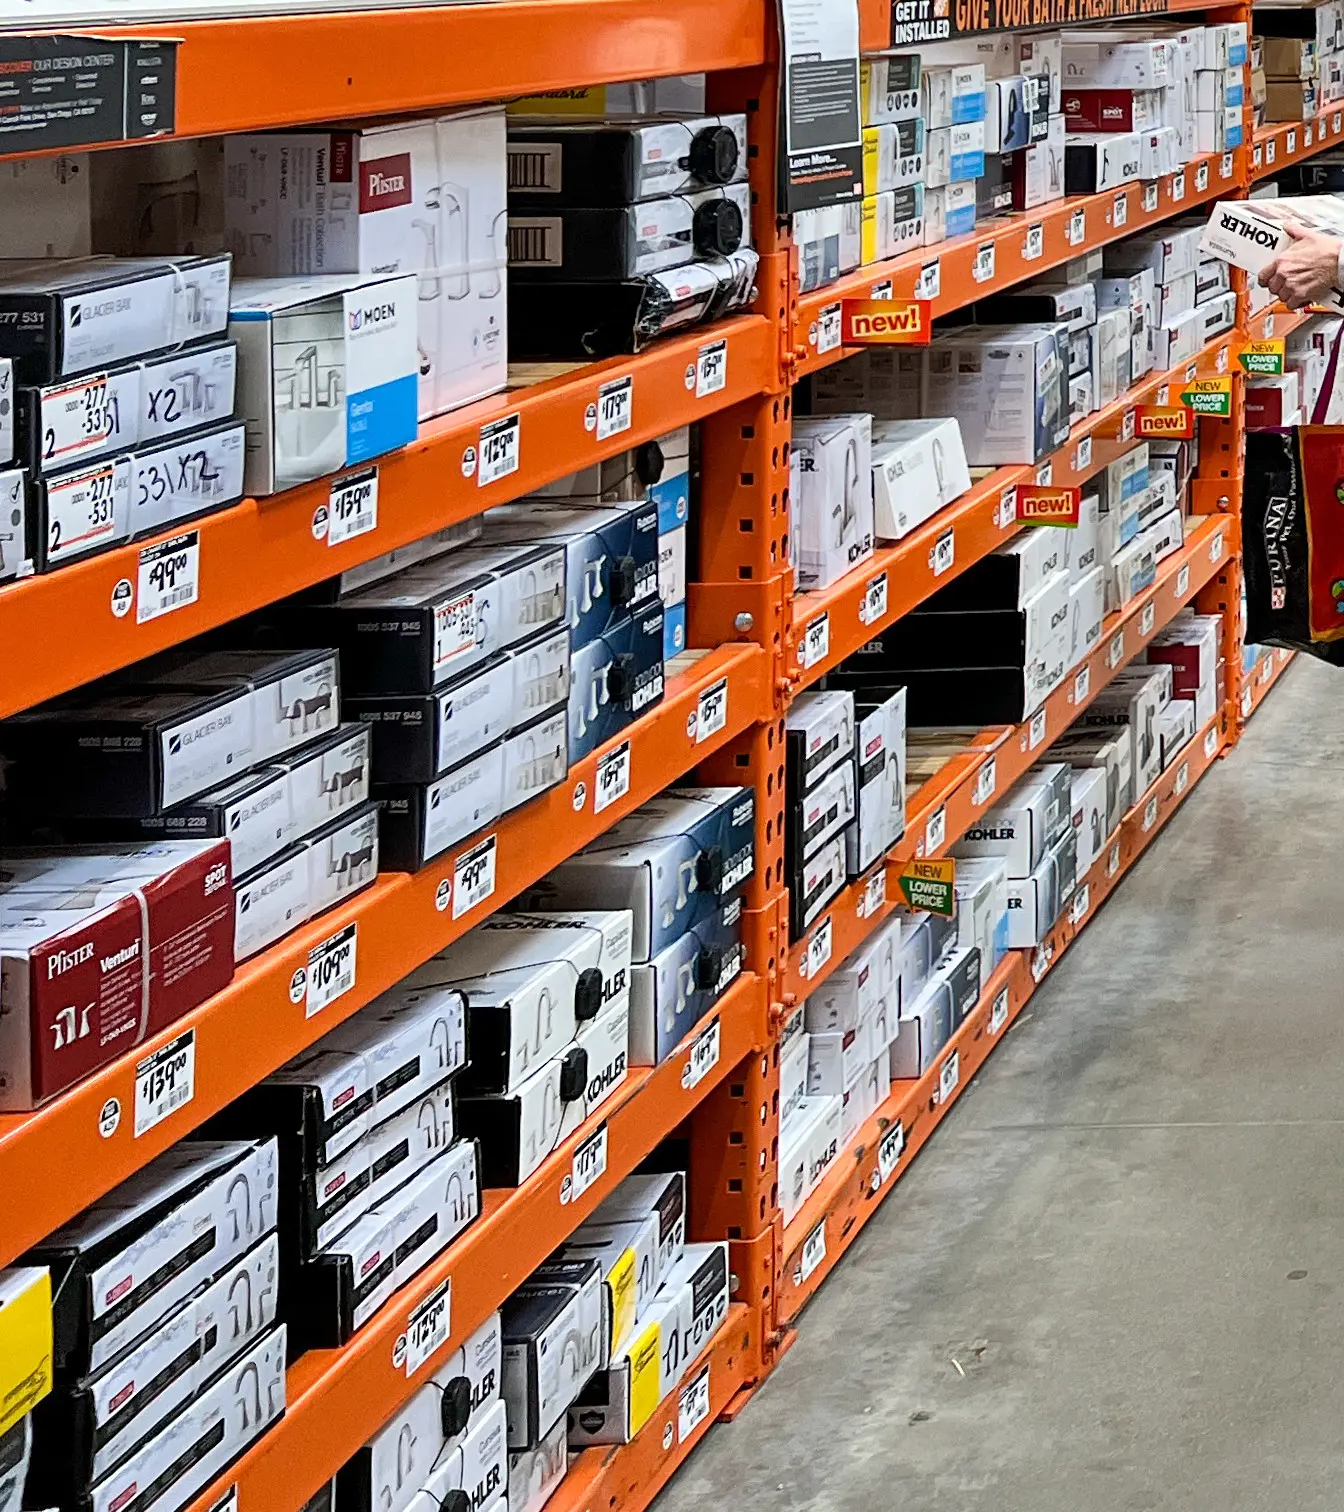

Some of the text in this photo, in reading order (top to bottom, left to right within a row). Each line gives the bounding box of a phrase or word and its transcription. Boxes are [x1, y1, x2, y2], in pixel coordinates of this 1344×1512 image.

[895, 0, 931, 22] GET IT
[895, 19, 950, 45] INSTALLED
[1220, 211, 1280, 250] KOHLER
[363, 303, 396, 325] MOEN
[852, 306, 921, 336] new!
[1249, 342, 1274, 354] NEW
[1245, 354, 1278, 365] LOWER
[1193, 380, 1222, 393] NEW
[1190, 394, 1226, 405] LOWER
[1023, 492, 1072, 515] new!
[1265, 502, 1287, 585] PURINA
[962, 828, 1014, 842] KOHLER
[913, 863, 943, 878] NEW
[908, 880, 948, 896] LOWER
[911, 893, 944, 909] PRICE
[100, 937, 141, 975] Venturi
[587, 1051, 627, 1105] KOHLER
